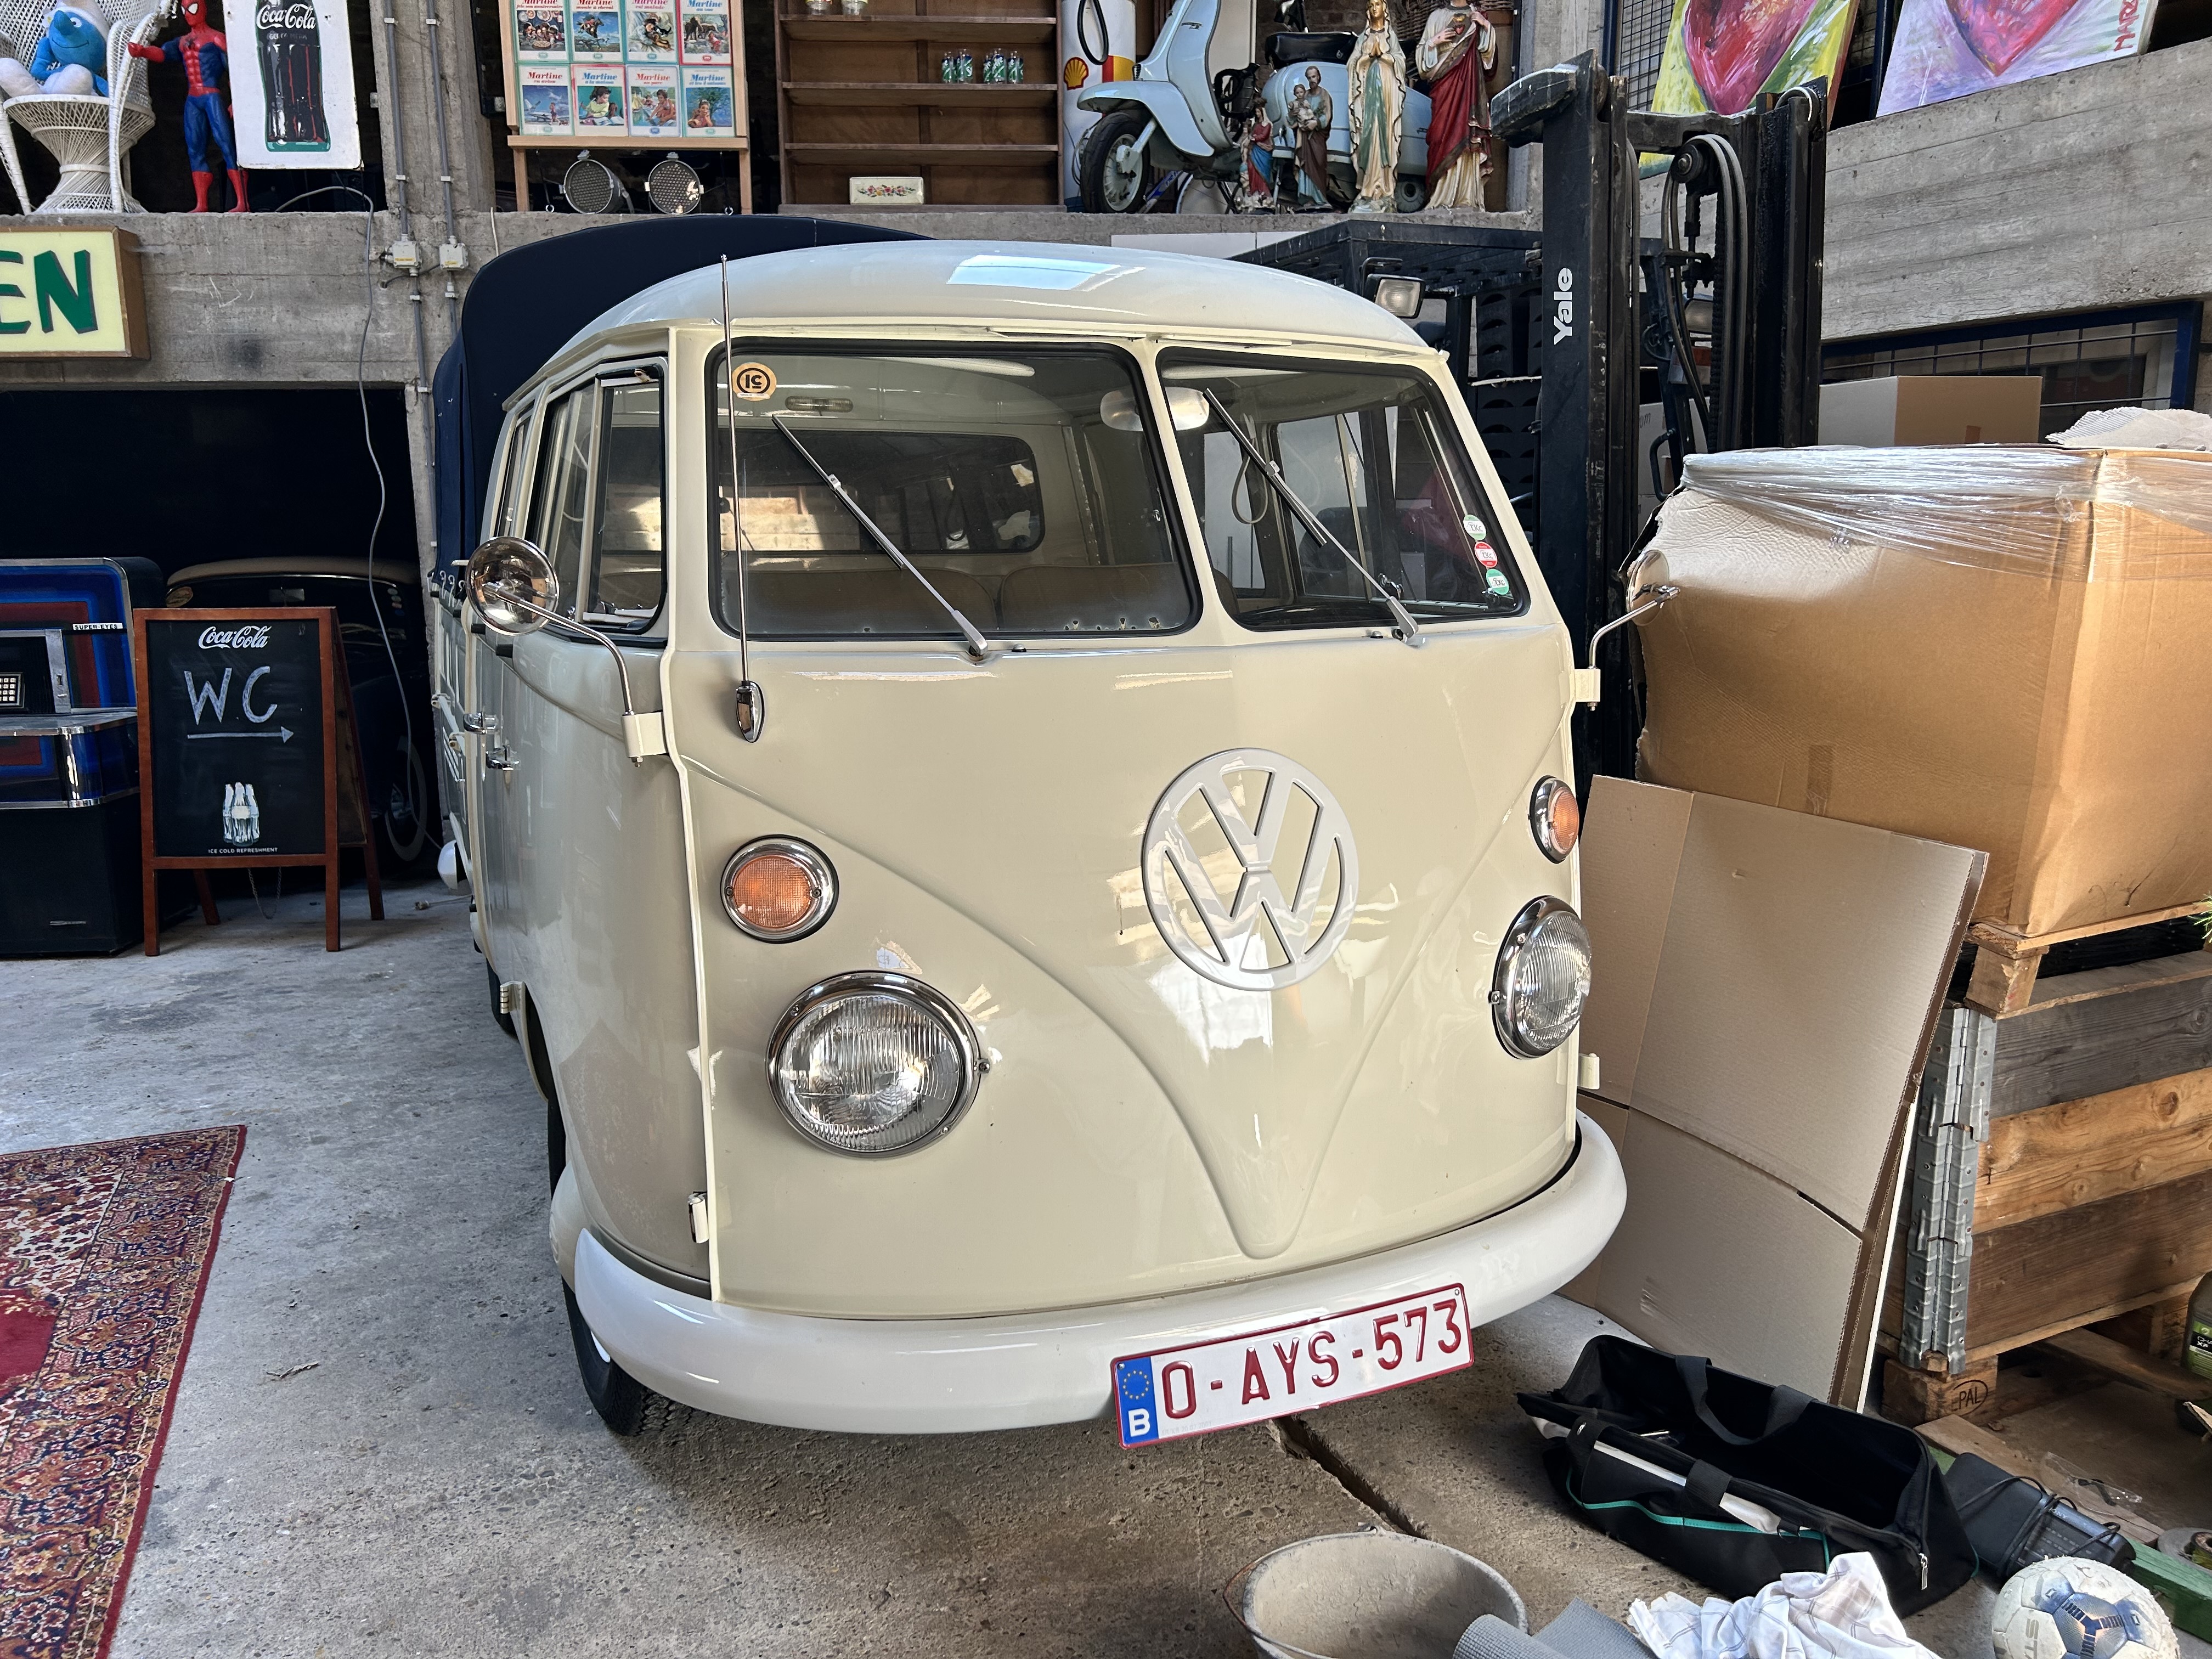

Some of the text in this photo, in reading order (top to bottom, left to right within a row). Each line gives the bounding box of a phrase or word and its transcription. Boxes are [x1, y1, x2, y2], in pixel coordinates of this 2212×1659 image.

[256, 3, 316, 30] Coca-Cola
[0, 250, 98, 334] EN
[1554, 268, 1573, 345] Yale
[198, 625, 272, 649] Coca-Cola
[1128, 1299, 1462, 1436] B O-AYS-573
